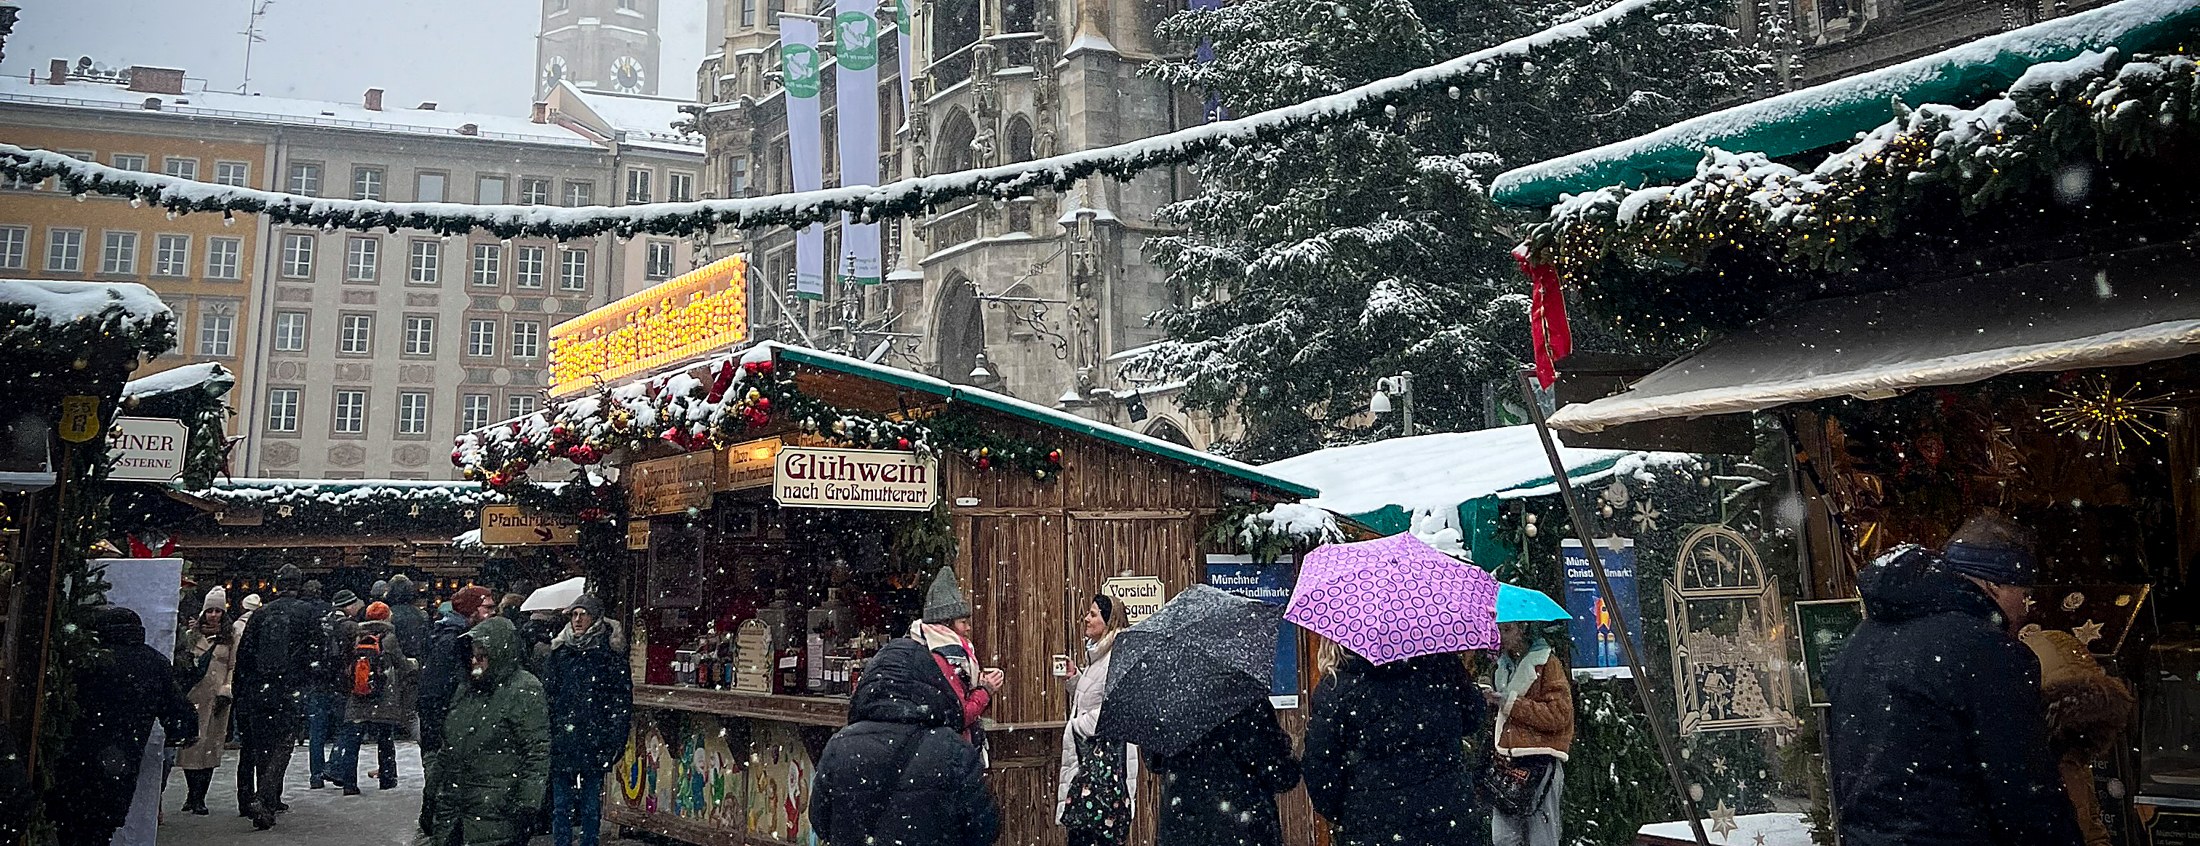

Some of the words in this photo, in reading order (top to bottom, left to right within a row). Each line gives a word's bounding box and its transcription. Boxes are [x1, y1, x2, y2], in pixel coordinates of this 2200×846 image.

[112, 434, 174, 451] HNER
[117, 457, 172, 468] SSTERNE
[785, 453, 926, 483] Glühwein
[783, 483, 818, 499] nach
[825, 483, 927, 503] Großmutterart
[1211, 574, 1259, 585] Münchner
[1110, 583, 1157, 598] Vorsicht
